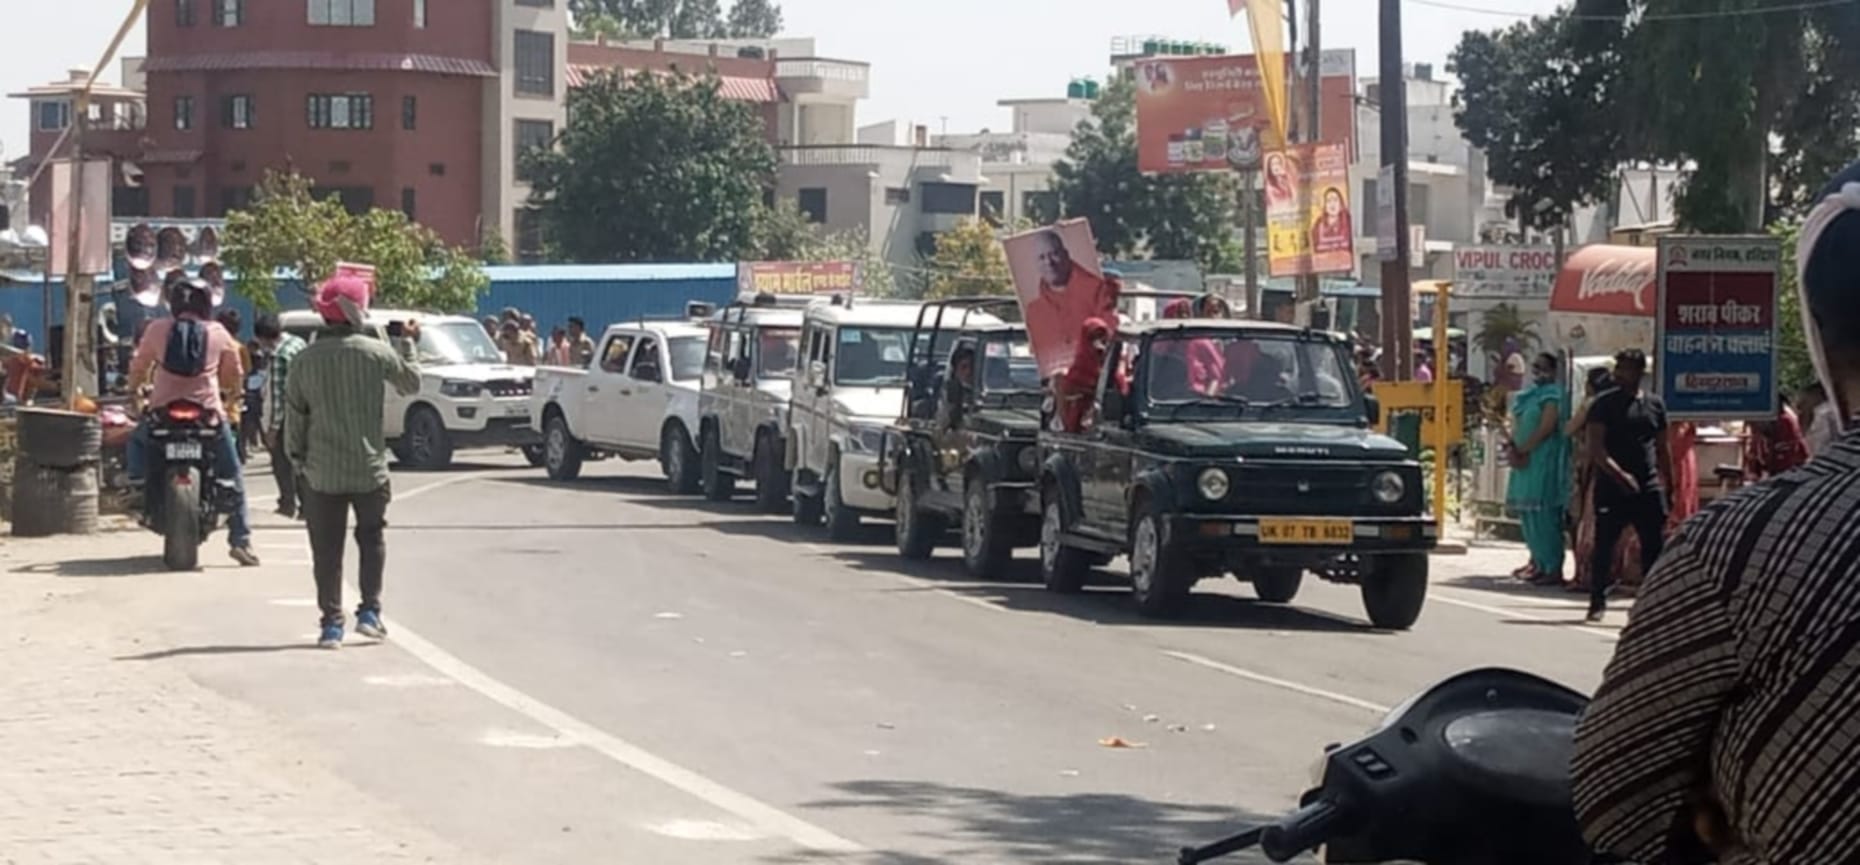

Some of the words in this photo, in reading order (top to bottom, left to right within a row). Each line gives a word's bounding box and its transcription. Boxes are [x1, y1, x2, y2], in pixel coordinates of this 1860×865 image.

[1456, 251, 1505, 270] VIPUL
[1509, 251, 1558, 270] CROC
[1677, 304, 1718, 324] शराब
[1720, 299, 1761, 324] पीकर
[1666, 335, 1707, 354] वाहन
[1707, 335, 1725, 354] न
